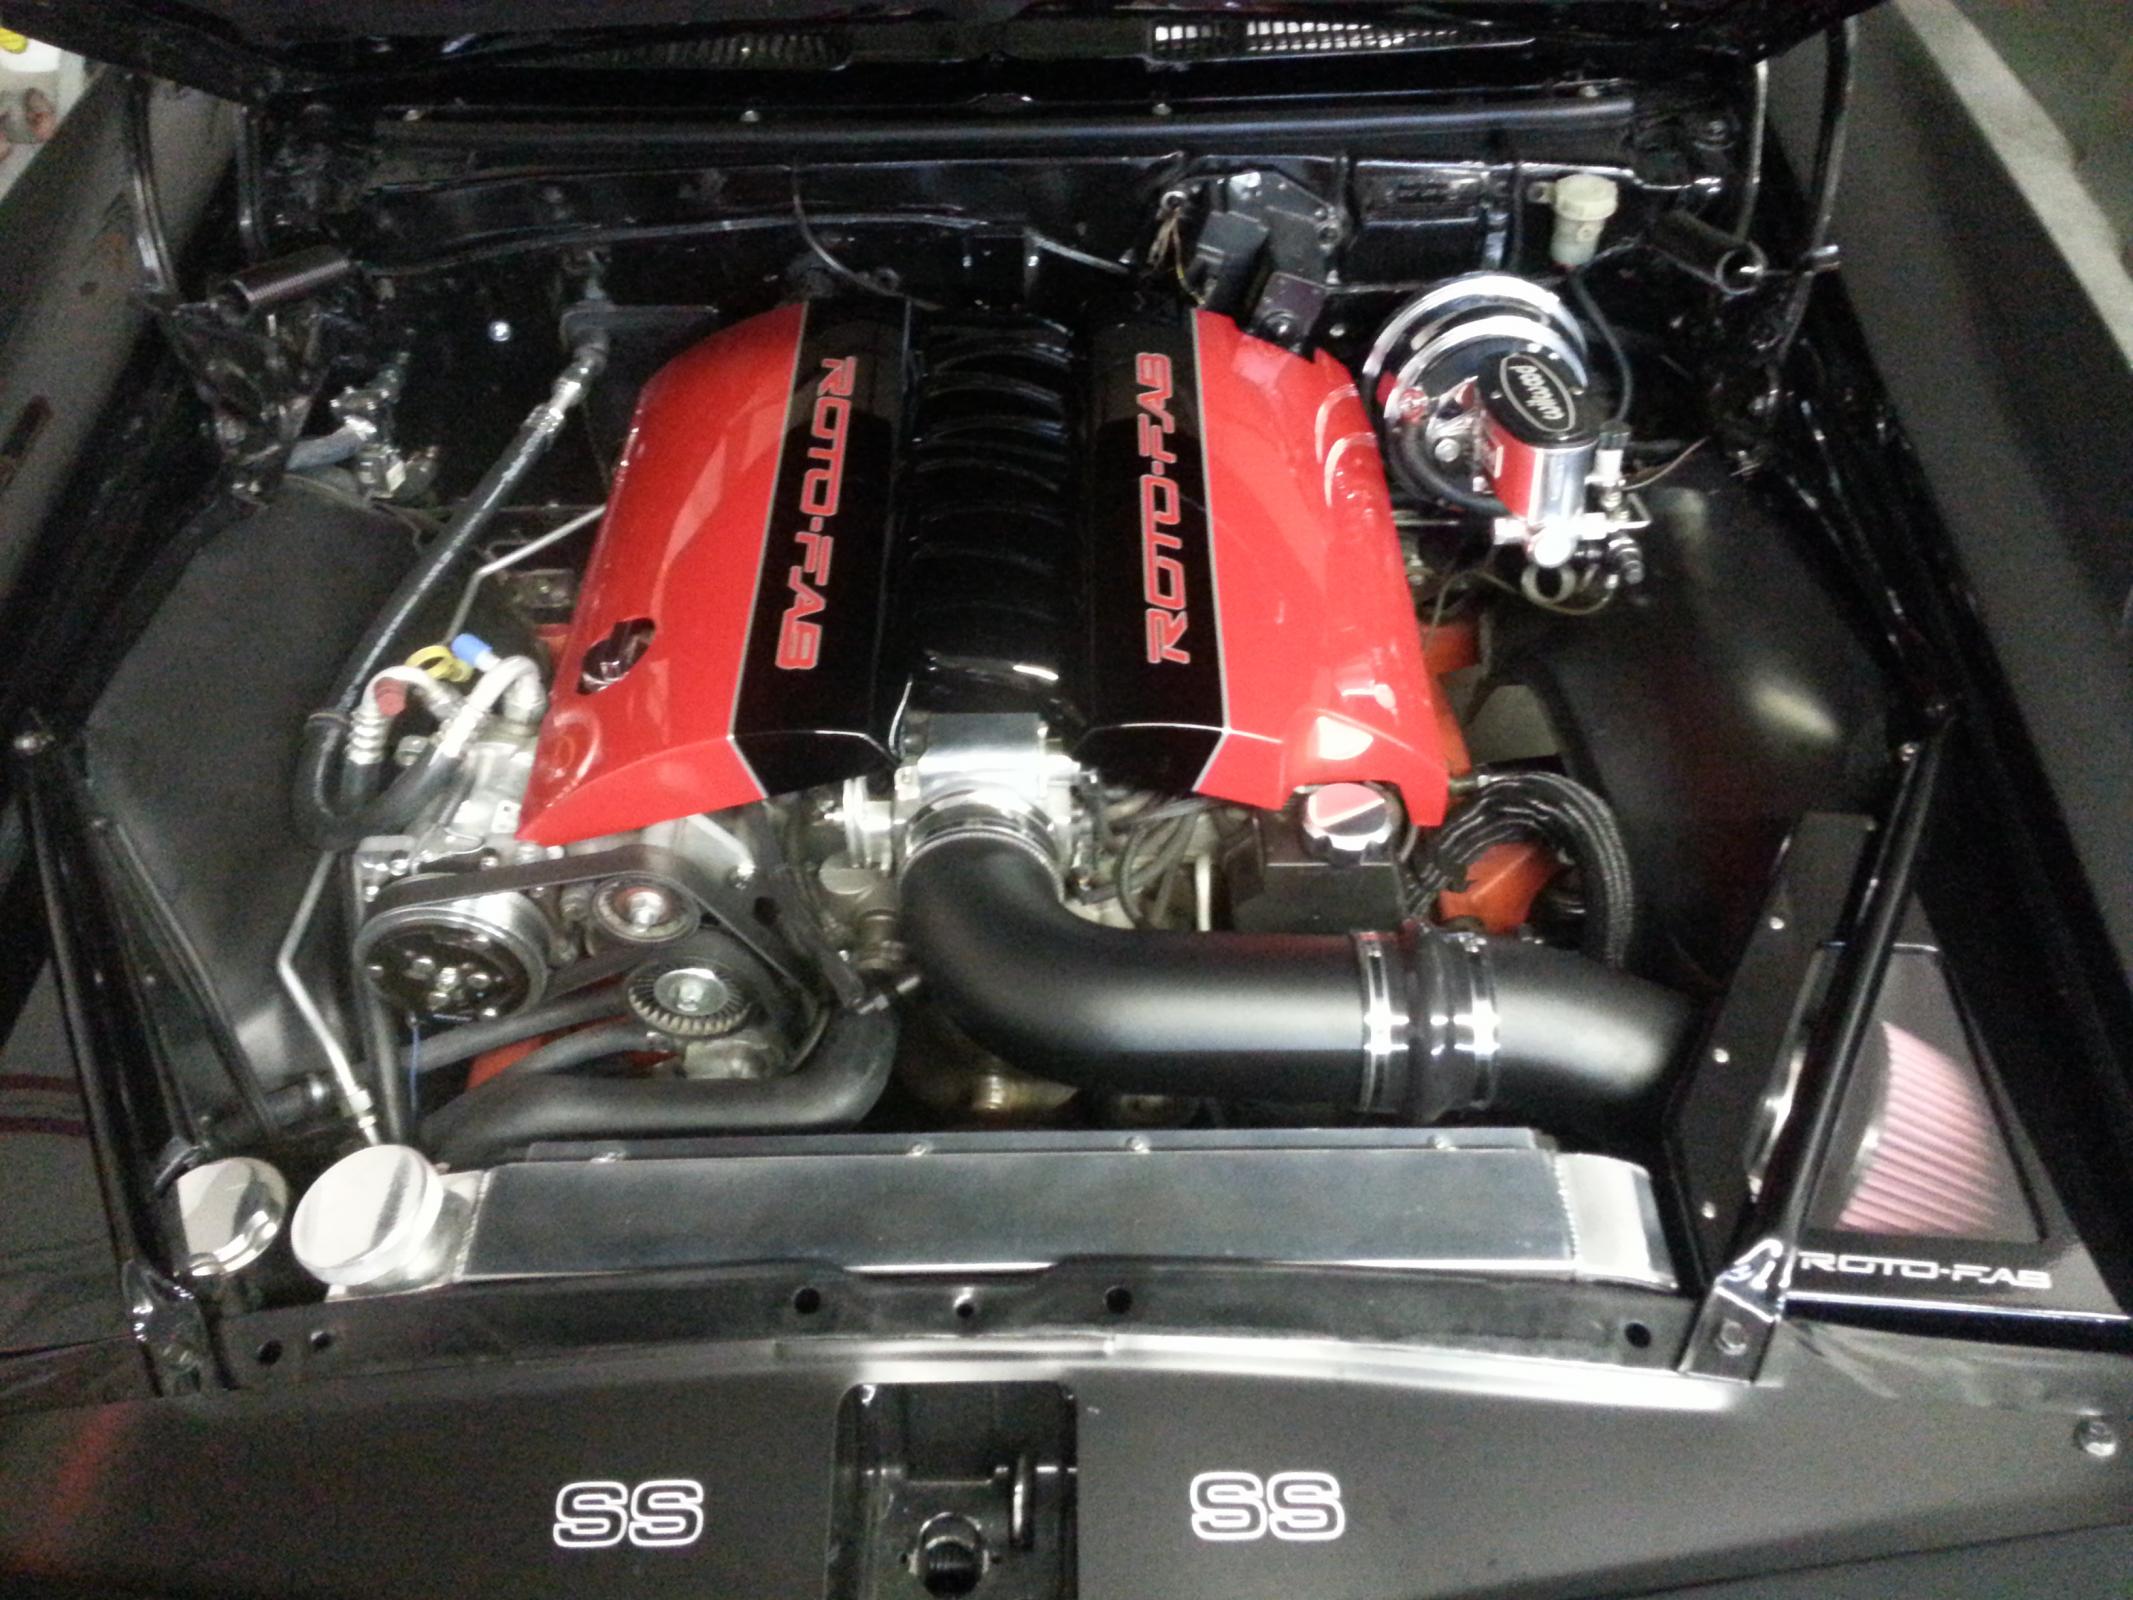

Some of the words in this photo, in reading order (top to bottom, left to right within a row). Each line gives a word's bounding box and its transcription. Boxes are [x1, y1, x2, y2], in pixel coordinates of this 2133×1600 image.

[775, 355, 857, 670] ROTO-FAB
[1135, 352, 1190, 665] ROTO-FAB
[1797, 1250, 2052, 1289] ROTO-FAB
[553, 1479, 704, 1548] SS
[1189, 1470, 1346, 1541] SS
